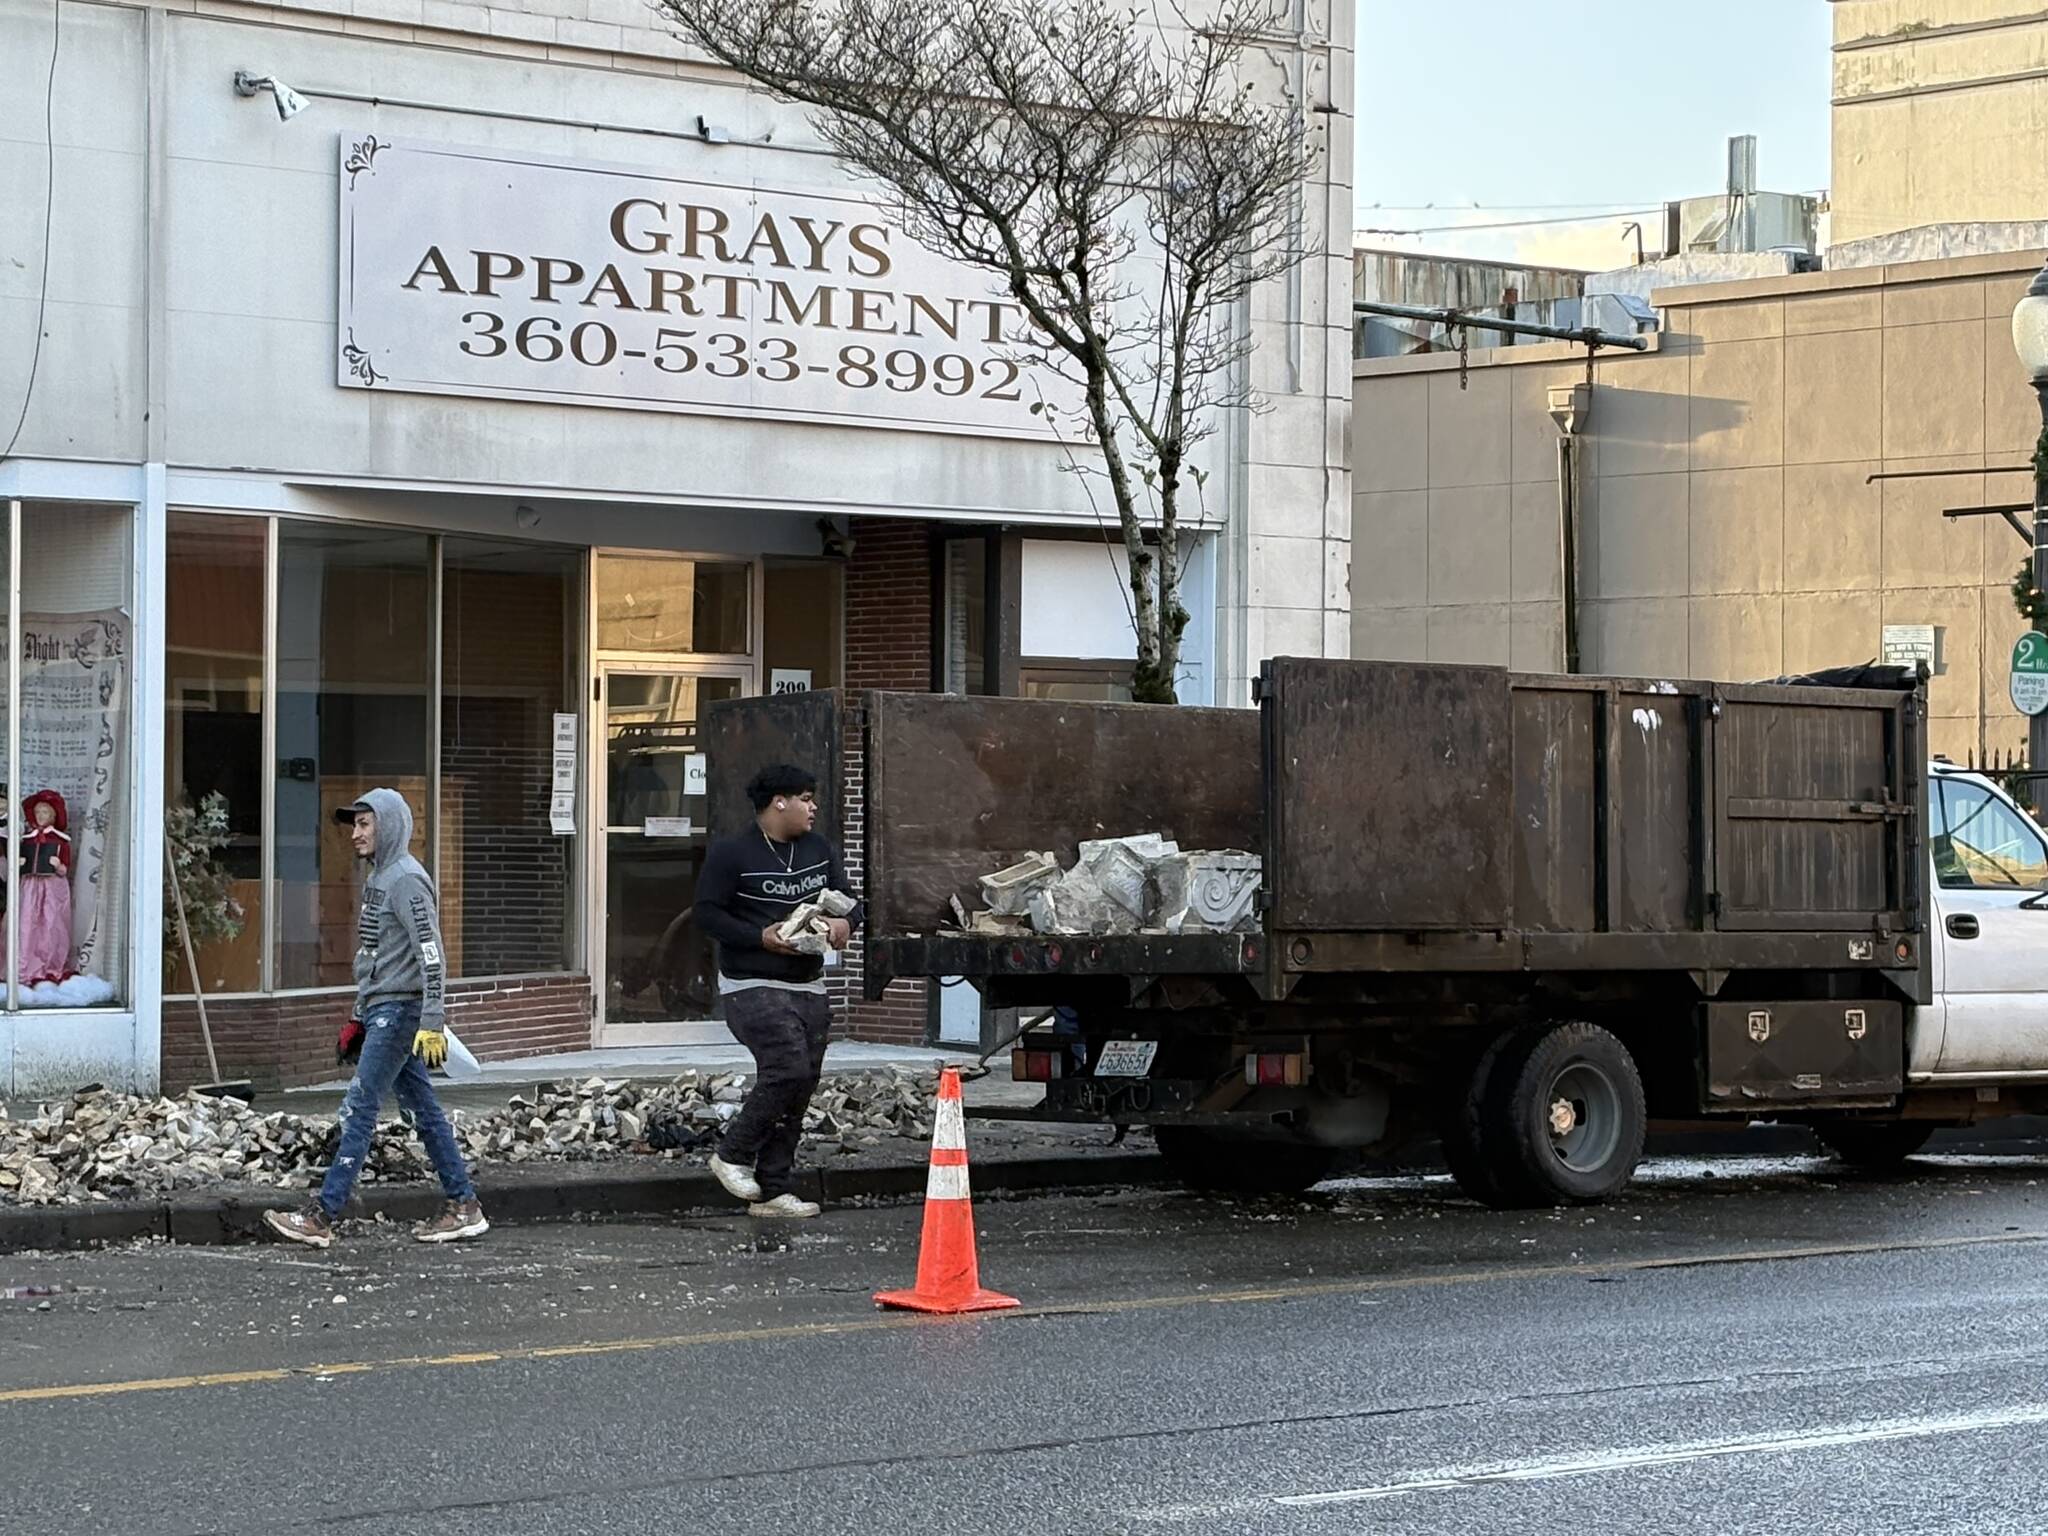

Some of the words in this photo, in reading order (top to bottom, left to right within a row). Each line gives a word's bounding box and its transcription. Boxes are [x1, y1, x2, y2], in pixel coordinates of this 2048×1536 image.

[609, 197, 892, 278] GRAYS
[458, 309, 1022, 402] 360-533-8992
[24, 631, 61, 665] Night
[2016, 638, 2034, 668] 2
[2017, 675, 2046, 689] Parking
[762, 879, 801, 896] Calvin
[801, 873, 828, 893] Klein
[424, 962, 442, 1000] ECKO
